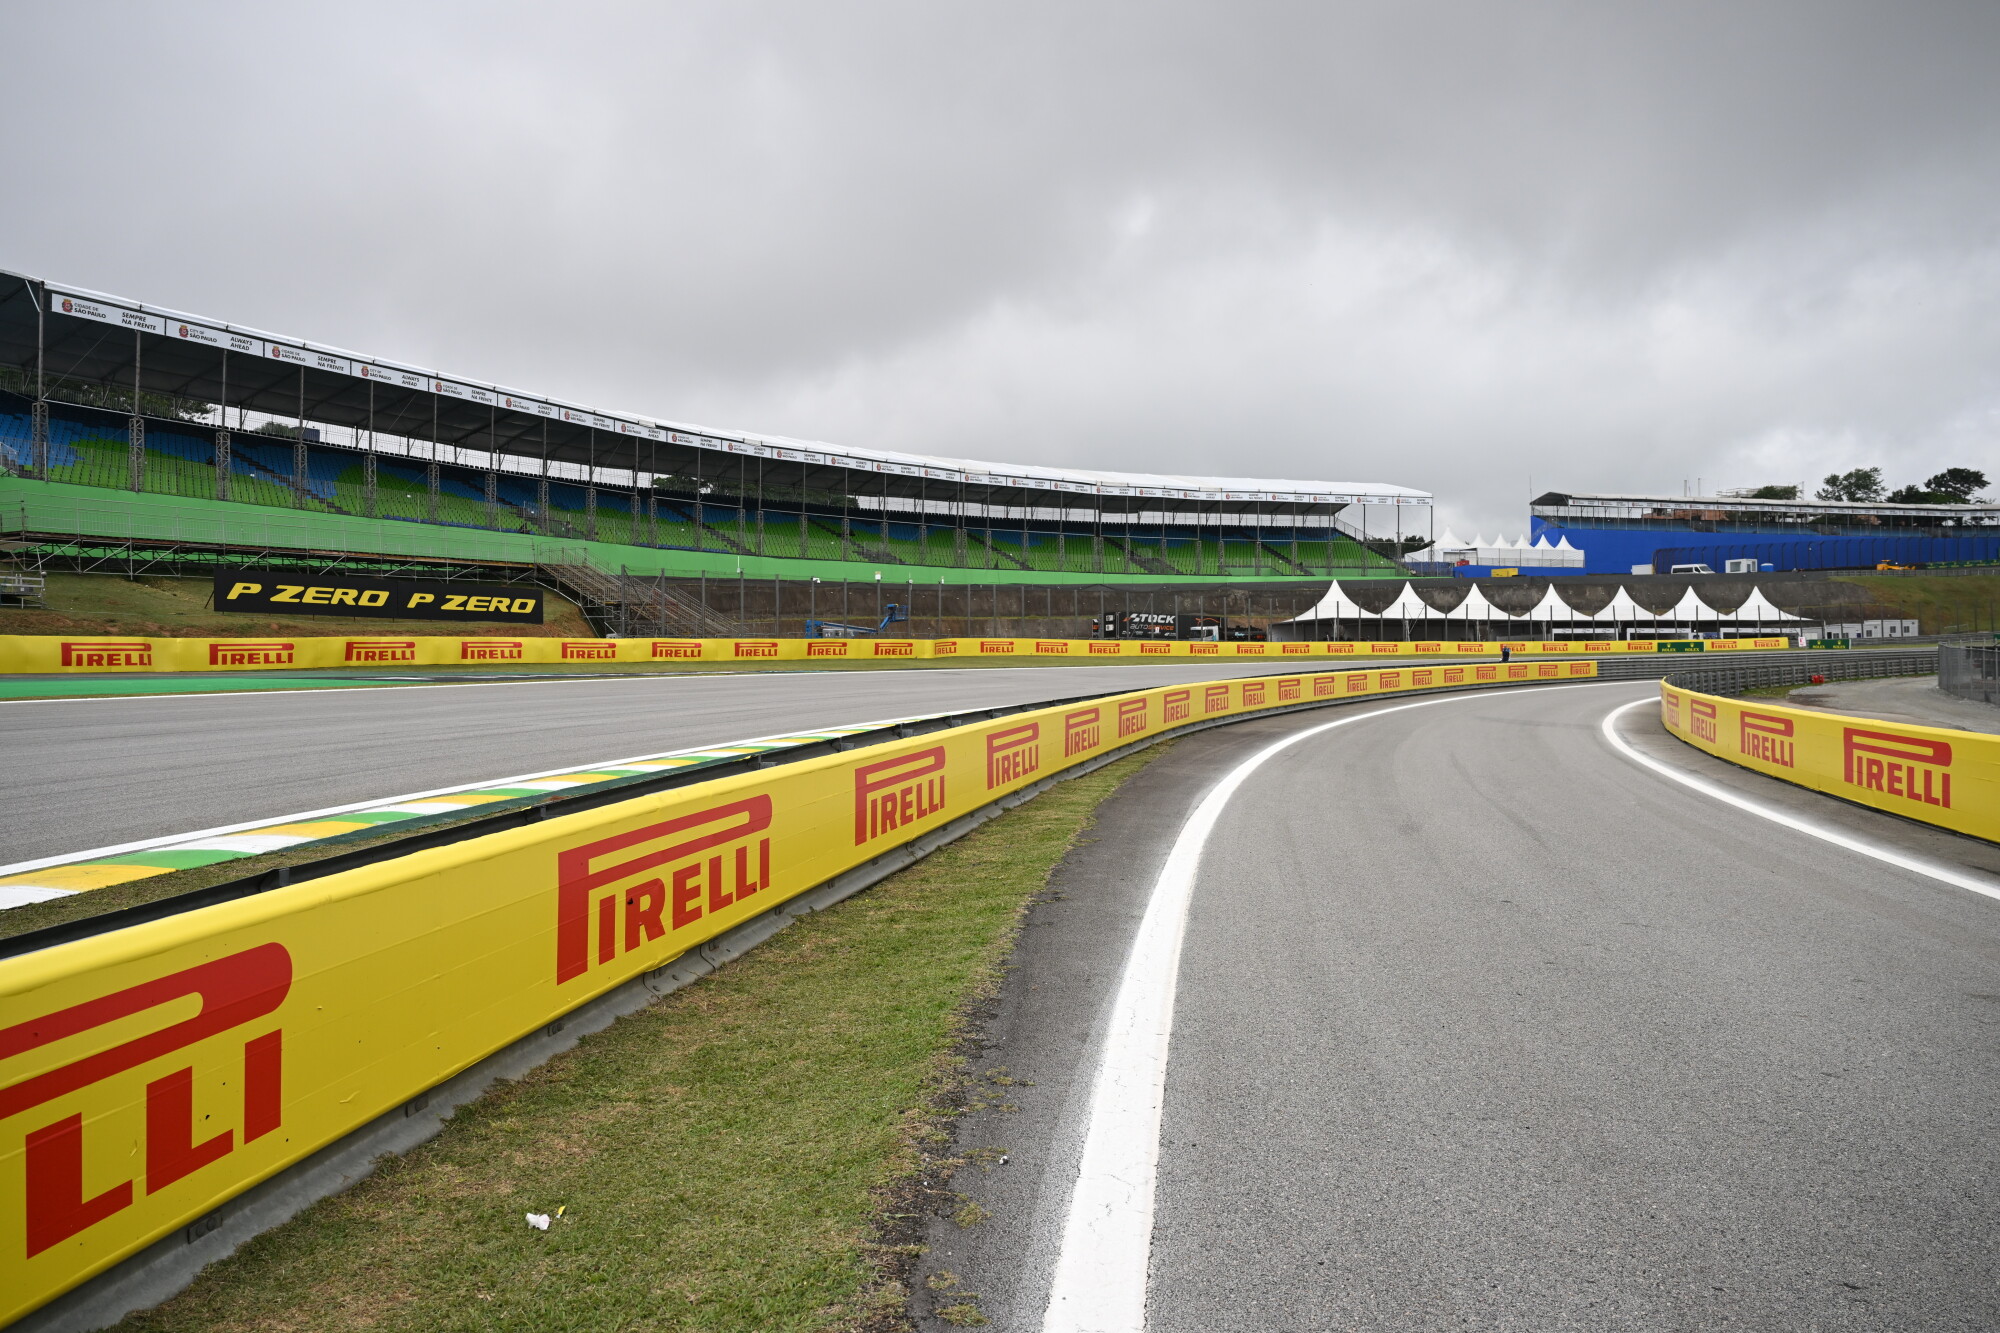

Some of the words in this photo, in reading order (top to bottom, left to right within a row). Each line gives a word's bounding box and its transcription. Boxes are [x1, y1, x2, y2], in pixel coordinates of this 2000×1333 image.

[74, 302, 92, 310] CIDADE
[87, 310, 107, 319] PAULO
[122, 311, 147, 322] SEMPRE
[121, 318, 132, 326] NA
[133, 321, 157, 331] FRENTE
[200, 335, 218, 343] PAULO
[230, 336, 253, 346] ALWAYS
[230, 342, 250, 351] AHEAD
[317, 356, 337, 364] SEMPRE
[326, 363, 344, 372] FRENTE
[227, 583, 261, 599] P
[270, 585, 389, 606] ZERO
[407, 593, 434, 608] P
[441, 595, 535, 613] ZERO
[460, 641, 523, 659] PIRELLI
[651, 642, 703, 658] PIRELLI
[734, 642, 779, 657] PIRELLI
[807, 642, 848, 656] PIRELLI
[874, 642, 914, 656] PIRELLI
[934, 641, 958, 654] PIRELLI
[979, 641, 1015, 653] PIRELLI
[1035, 641, 1069, 653] PIRELLI
[1088, 643, 1121, 653] PIRELLI
[1140, 643, 1172, 654] PIRELLI
[1189, 644, 1219, 654] PIRELLI
[1236, 644, 1265, 654] PIRELLI
[1282, 644, 1311, 654] PIRELLI
[1327, 644, 1356, 653] PIRELLI
[1371, 644, 1399, 653] PIRELLI
[1415, 643, 1441, 652] PIRELLI
[1457, 644, 1484, 652] PIRELLI
[1542, 643, 1568, 652] PIRELLI
[1584, 643, 1611, 651] PIRELLI
[1627, 642, 1654, 651] PIRELLI
[1711, 641, 1739, 649] PIRELLI
[1754, 639, 1780, 648] PIRELLI
[60, 642, 152, 666] PIRELLI
[208, 643, 295, 665] PIRELLI
[344, 641, 416, 661] PIRELLI
[561, 642, 618, 659] PIRELLI
[1443, 668, 1465, 683] PIRELLI
[1475, 666, 1497, 680] PIRELLI
[1508, 665, 1529, 678] PIRELLI
[1538, 664, 1560, 676] PIRELLI
[1569, 663, 1592, 675] PIRELLI
[1347, 674, 1369, 692] PIRELLI
[1379, 672, 1401, 688] PIRELLI
[1412, 670, 1433, 685] PIRELLI
[1278, 679, 1301, 700] PIRELLI
[1313, 676, 1336, 696] PIRELLI
[1205, 685, 1230, 712] PIRELLI
[1242, 682, 1265, 706] PIRELLI
[1163, 690, 1191, 723] PIRELLI
[1118, 698, 1147, 738] PIRELLI
[1690, 699, 1717, 745] PIRELLI
[1064, 708, 1100, 757] PIRELLI
[1740, 711, 1794, 768] PIRELLI
[986, 722, 1040, 790] PIRELLI
[1843, 727, 1953, 809] PIRELLI
[854, 746, 946, 846] PIRELLI
[555, 794, 773, 986] PIRELLI
